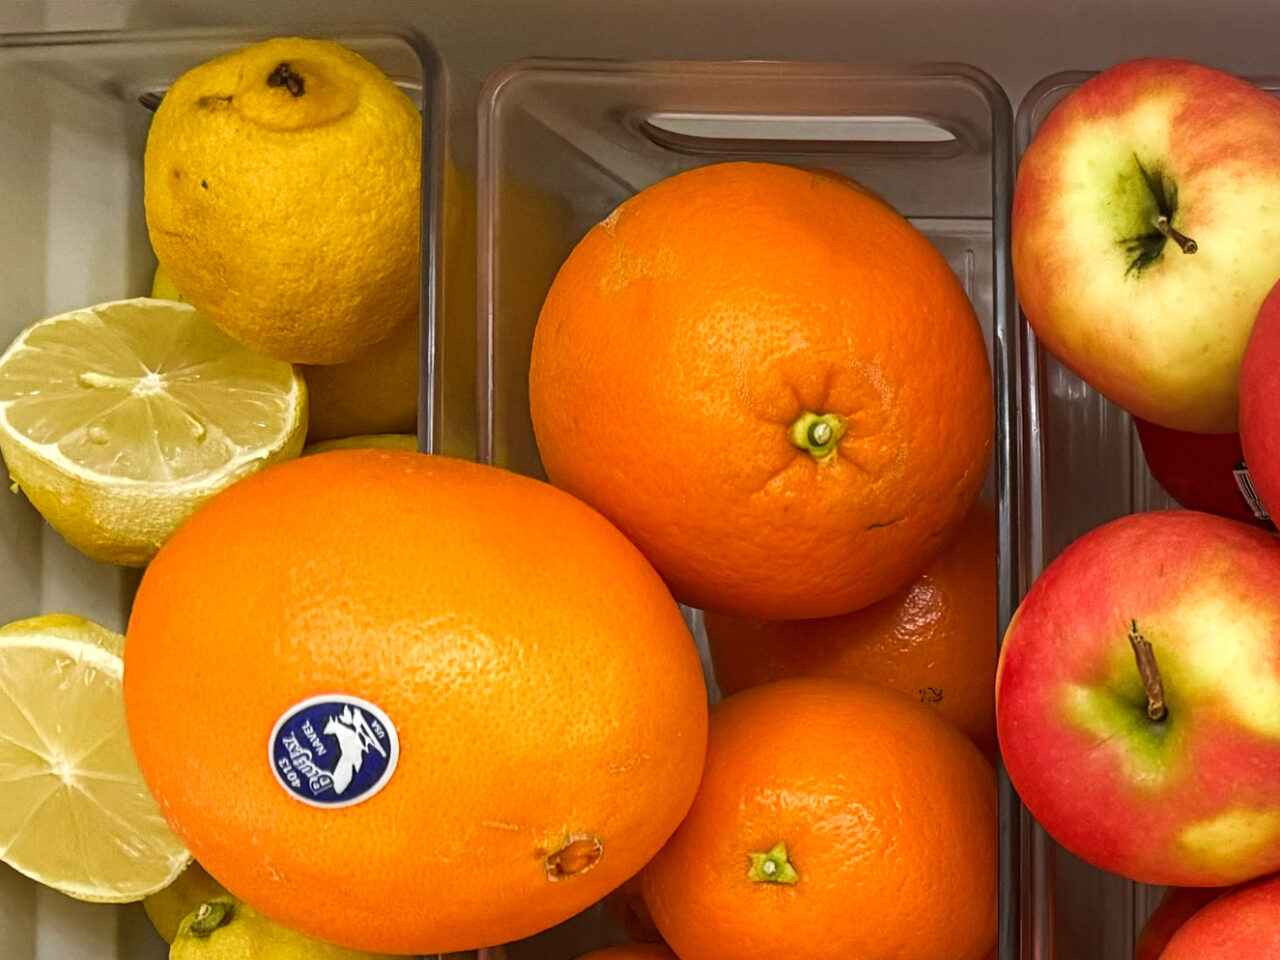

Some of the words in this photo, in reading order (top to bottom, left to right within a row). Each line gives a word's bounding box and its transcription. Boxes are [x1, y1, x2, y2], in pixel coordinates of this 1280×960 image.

[301, 719, 327, 756] NAVEL
[371, 719, 386, 739] USA
[278, 757, 301, 788] 4013
